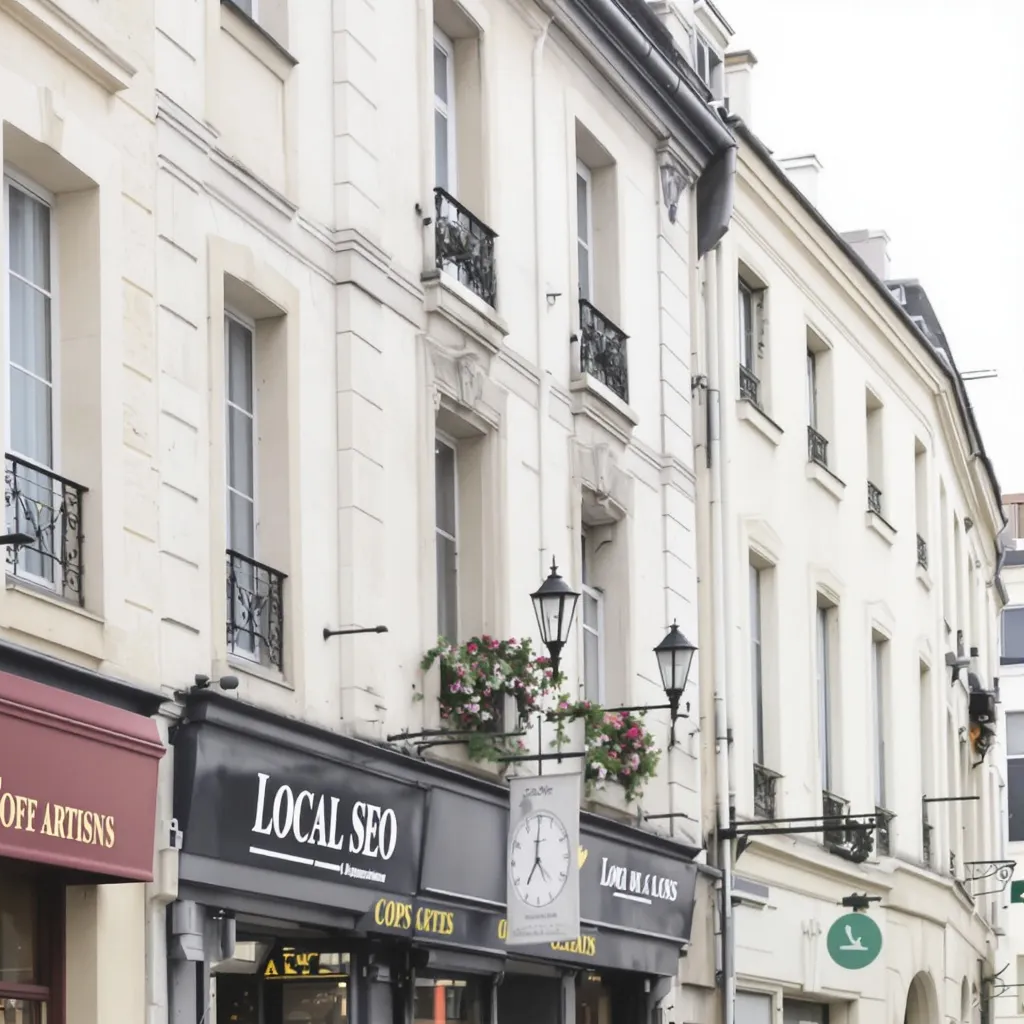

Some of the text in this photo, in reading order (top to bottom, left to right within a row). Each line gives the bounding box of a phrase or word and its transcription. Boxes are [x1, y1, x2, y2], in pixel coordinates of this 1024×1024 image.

[40, 804, 115, 849] ARTISNS
[251, 772, 398, 861] LOCAL SEO
